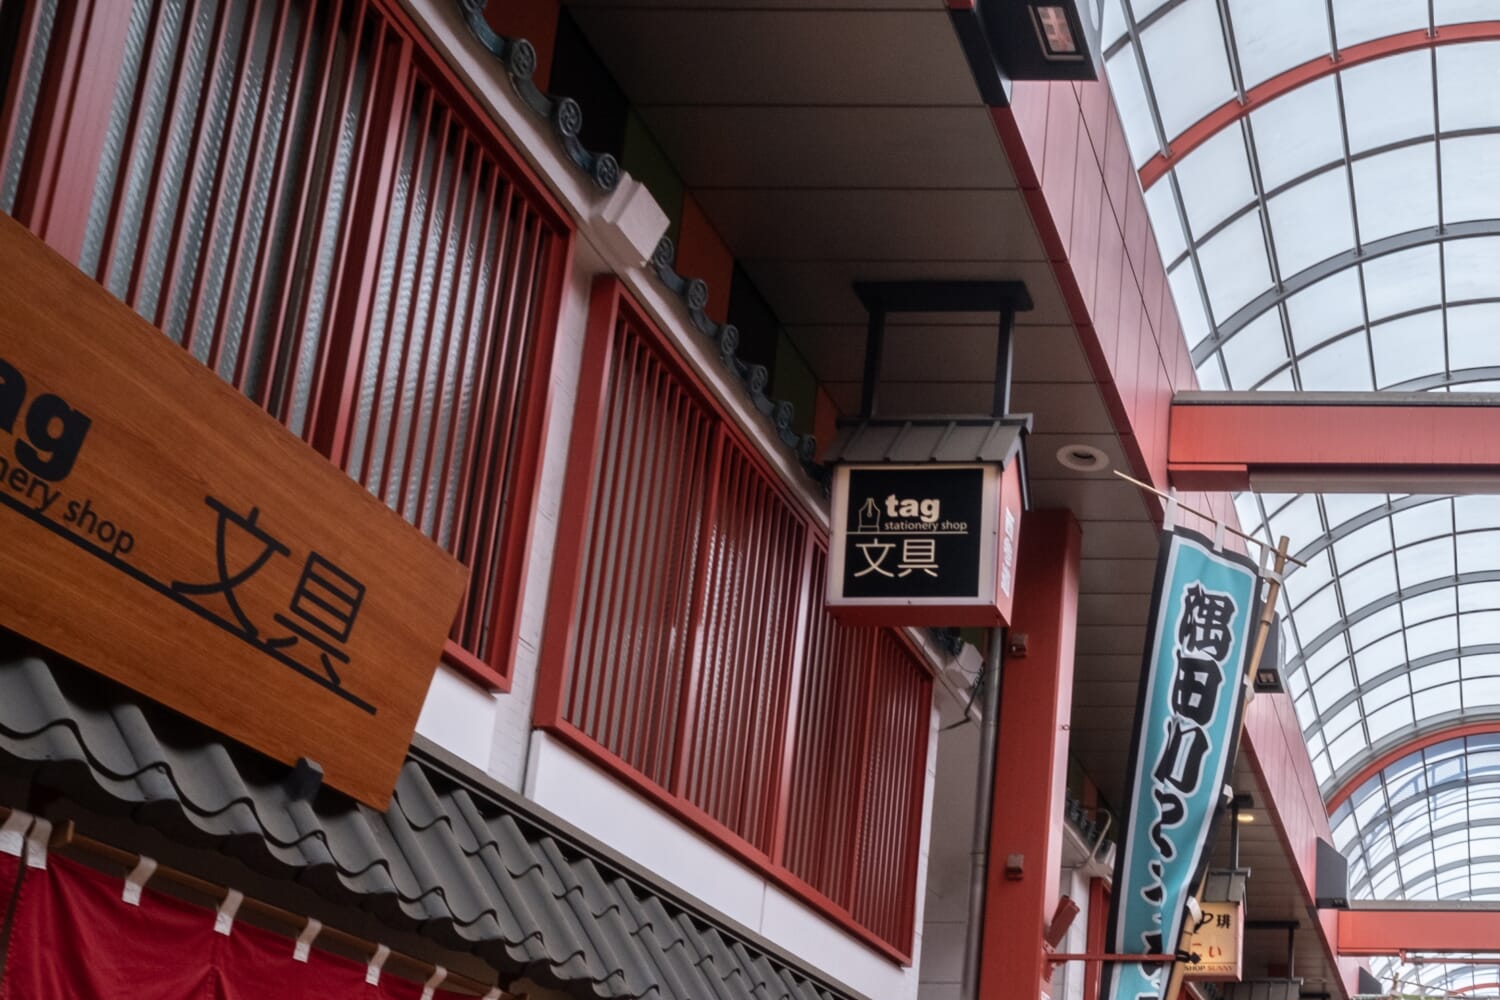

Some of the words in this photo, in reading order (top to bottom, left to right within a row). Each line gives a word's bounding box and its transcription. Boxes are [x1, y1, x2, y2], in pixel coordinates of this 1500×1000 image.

[63, 499, 135, 556] shop
[884, 493, 940, 522] tag
[884, 519, 939, 533] stationery
[940, 519, 967, 533] shop
[853, 537, 939, 578] 文具
[172, 495, 366, 688] 文具
